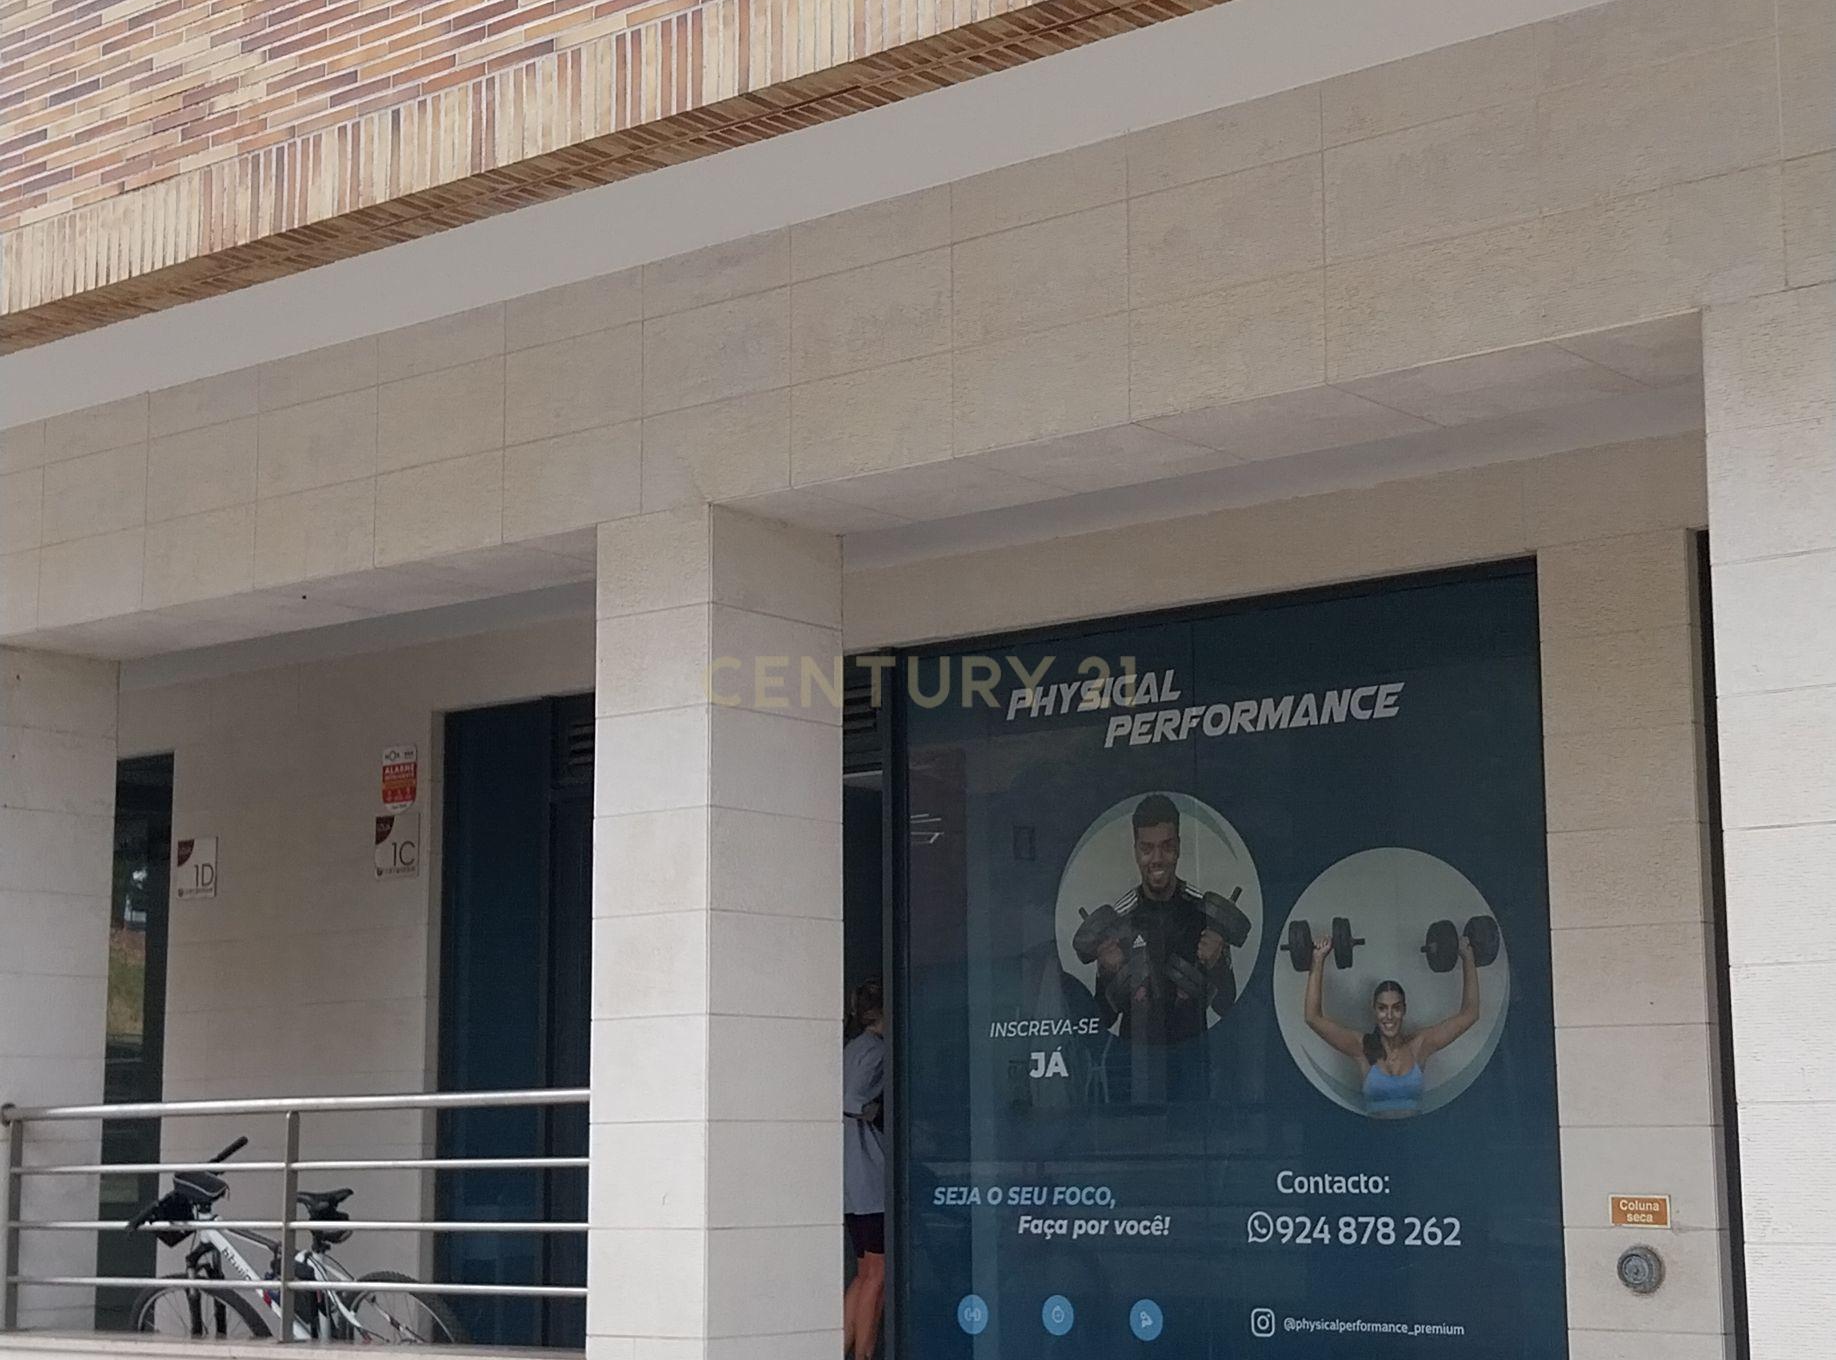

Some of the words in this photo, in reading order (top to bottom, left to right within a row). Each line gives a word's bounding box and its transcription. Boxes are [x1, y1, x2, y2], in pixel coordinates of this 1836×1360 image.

[1006, 669, 1181, 721] PHYSICAL
[1104, 682, 1405, 748] PERFORMANCE
[391, 840, 416, 866] 1C
[194, 863, 214, 887] 1D
[990, 1018, 1100, 1038] INSCREVA-SE
[1029, 1046, 1069, 1078] JÁ
[1277, 1171, 1390, 1194] Contacto:
[933, 1186, 981, 1206] SEJA
[987, 1186, 1002, 1206] O
[1007, 1186, 1047, 1206] SEU
[1053, 1186, 1116, 1209] FOCO,
[1619, 1199, 1660, 1212] Coluna
[1018, 1215, 1067, 1240] Faça
[1072, 1219, 1109, 1239] por
[1114, 1215, 1171, 1236] você!
[1626, 1212, 1654, 1223] seca
[1276, 1216, 1331, 1244] 924
[1338, 1216, 1396, 1245] 878
[1404, 1217, 1462, 1246] 262
[1283, 1316, 1465, 1336] @physicalperformance_premium
